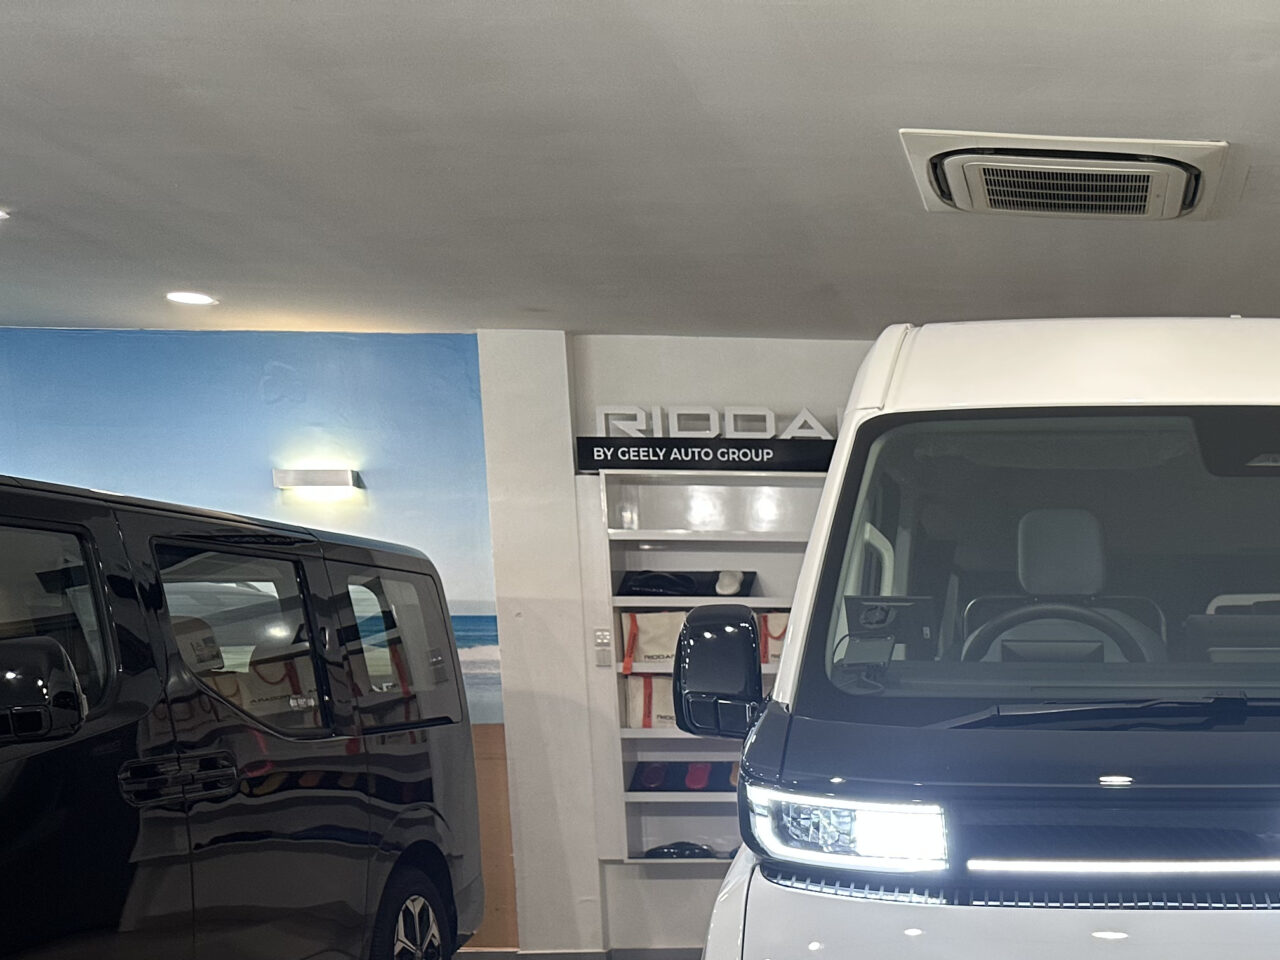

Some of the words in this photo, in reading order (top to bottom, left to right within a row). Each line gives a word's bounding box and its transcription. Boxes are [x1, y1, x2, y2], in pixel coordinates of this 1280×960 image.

[596, 406, 843, 440] RIDDA
[593, 447, 613, 460] BY
[617, 448, 666, 461] GEELY
[670, 448, 713, 461] AUTO
[717, 449, 774, 462] GROUP
